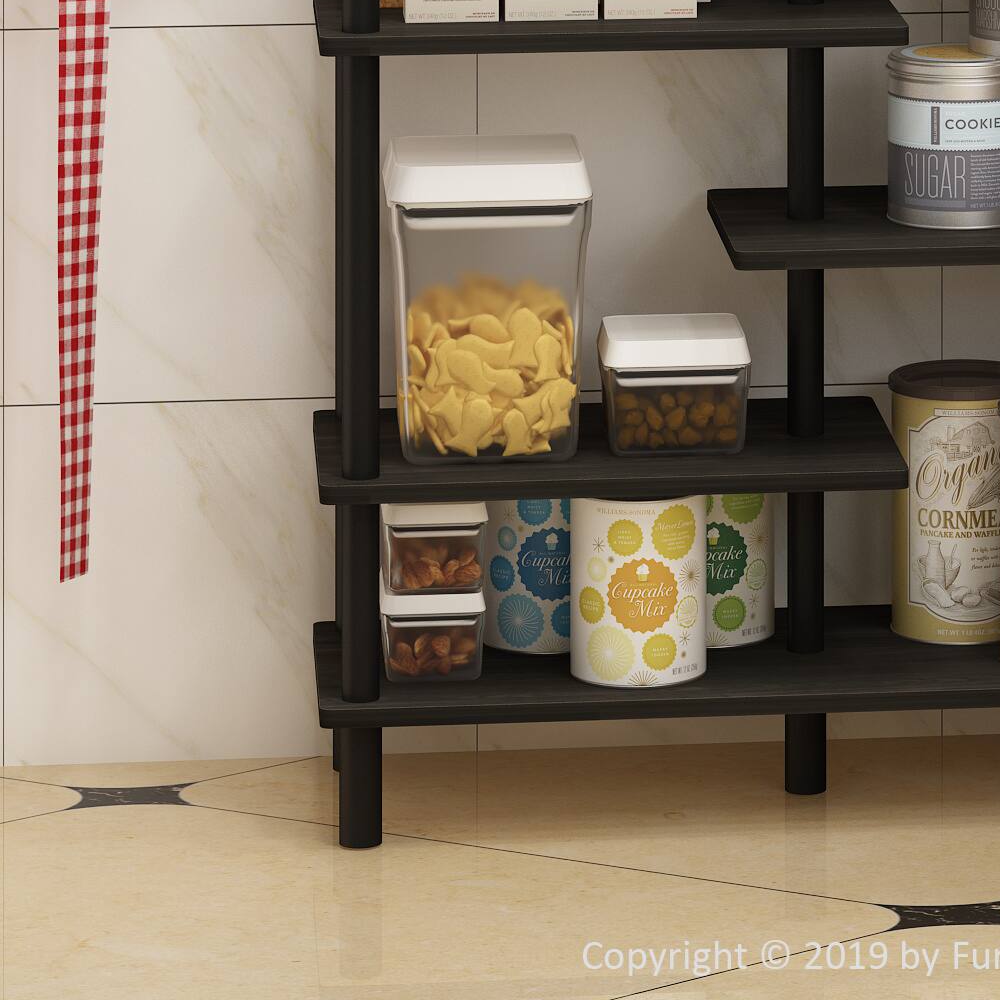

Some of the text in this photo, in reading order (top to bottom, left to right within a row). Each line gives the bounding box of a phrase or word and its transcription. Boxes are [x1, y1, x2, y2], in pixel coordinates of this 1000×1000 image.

[945, 117, 1000, 130] COOKIE
[904, 151, 966, 199] SUGAR
[920, 529, 954, 538] PANCAKE
[538, 567, 570, 586] Mi
[611, 581, 673, 604] Cupcake
[629, 599, 668, 618] Mix
